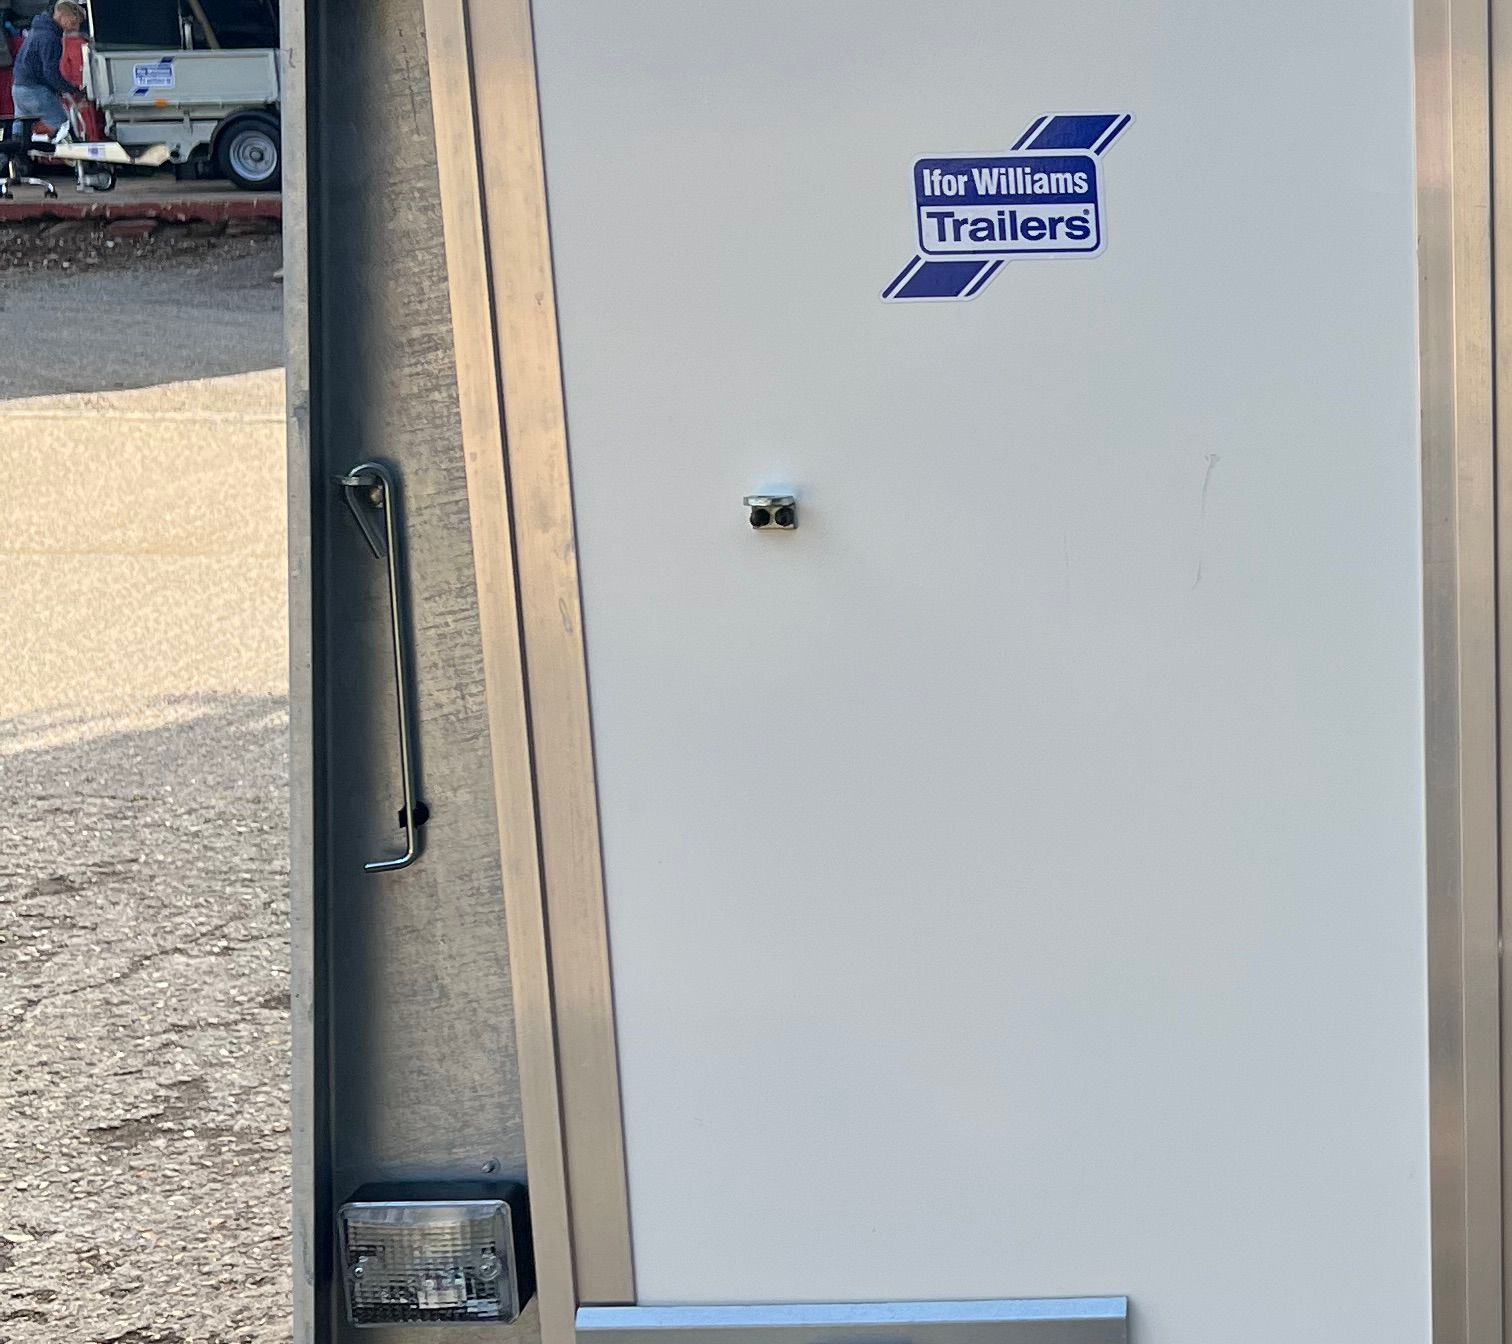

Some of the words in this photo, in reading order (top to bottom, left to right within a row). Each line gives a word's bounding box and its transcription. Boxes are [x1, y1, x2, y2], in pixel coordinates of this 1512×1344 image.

[922, 168, 968, 196] Ifor
[971, 167, 1089, 196] Williams
[926, 210, 1091, 242] Trailers
